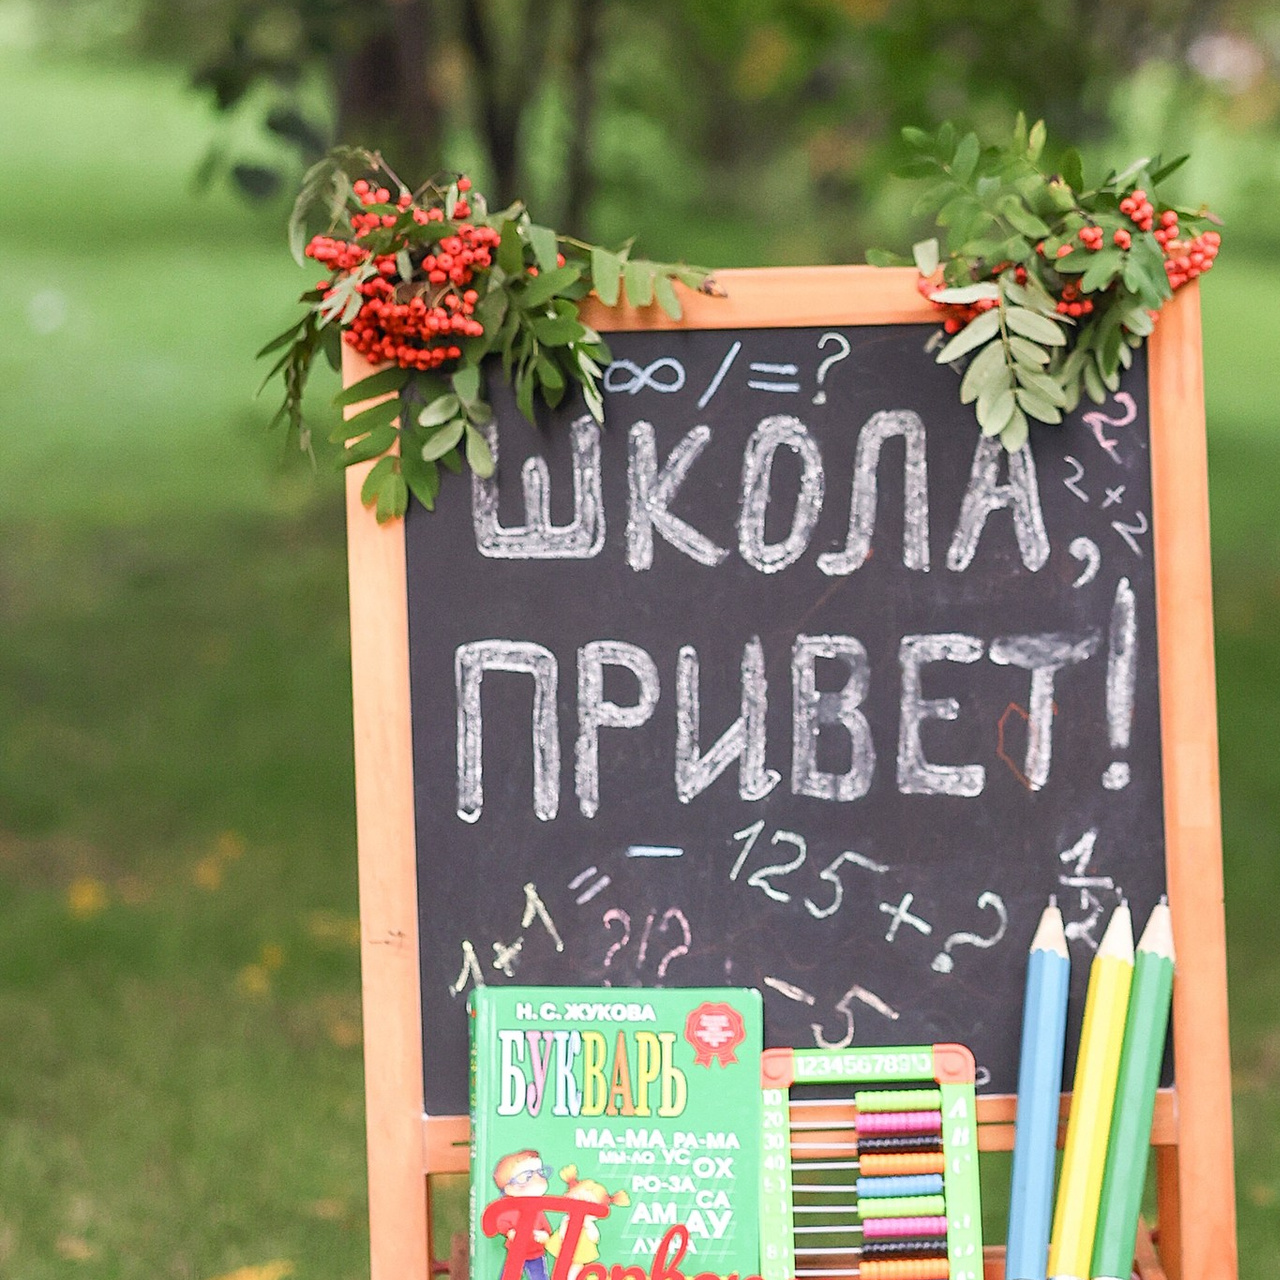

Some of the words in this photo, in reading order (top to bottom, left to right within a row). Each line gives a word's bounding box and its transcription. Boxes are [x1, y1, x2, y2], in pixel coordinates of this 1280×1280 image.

[472, 409, 1100, 588] ШКОЛА,
[454, 578, 1137, 823] ПРИВЕТ!
[497, 1030, 688, 1117] БУКВАРЬ
[575, 1128, 666, 1149] МА-МА
[673, 1131, 740, 1149] РА-МА
[661, 1148, 691, 1165] УС
[692, 1157, 735, 1179] ОХ
[632, 1175, 696, 1193] РО-ЗА
[696, 1190, 731, 1209] СА
[631, 1202, 678, 1224] АМ
[686, 1209, 734, 1239] АУ
